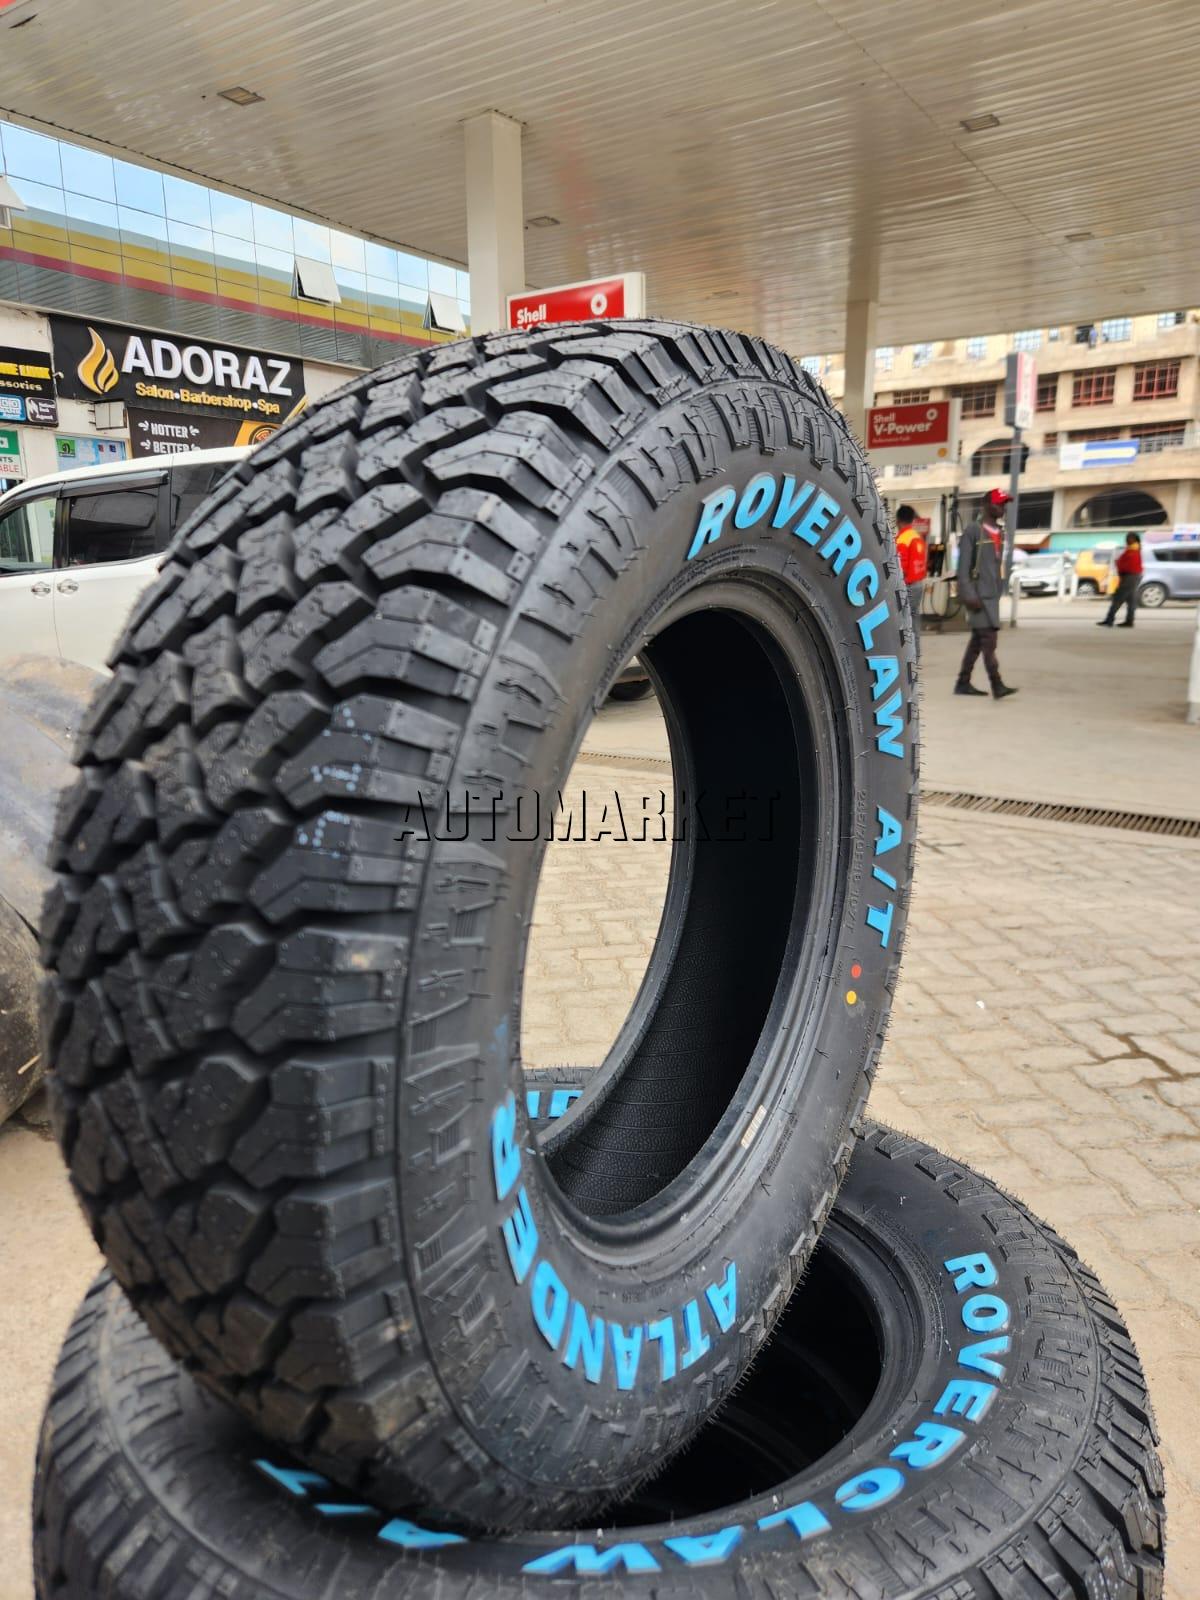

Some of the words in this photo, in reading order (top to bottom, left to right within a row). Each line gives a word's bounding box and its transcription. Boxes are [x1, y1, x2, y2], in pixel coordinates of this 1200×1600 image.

[517, 304, 547, 325] Shell
[121, 335, 292, 396] ADORAZ
[151, 422, 189, 439] HOTTER
[873, 412, 896, 424] Shell
[873, 422, 933, 436] V-Power
[687, 471, 904, 759] ROVERCLAW
[866, 805, 903, 949] A/T
[490, 1088, 738, 1391] ATLANDER
[521, 1252, 1011, 1575] ROVERCLAW
